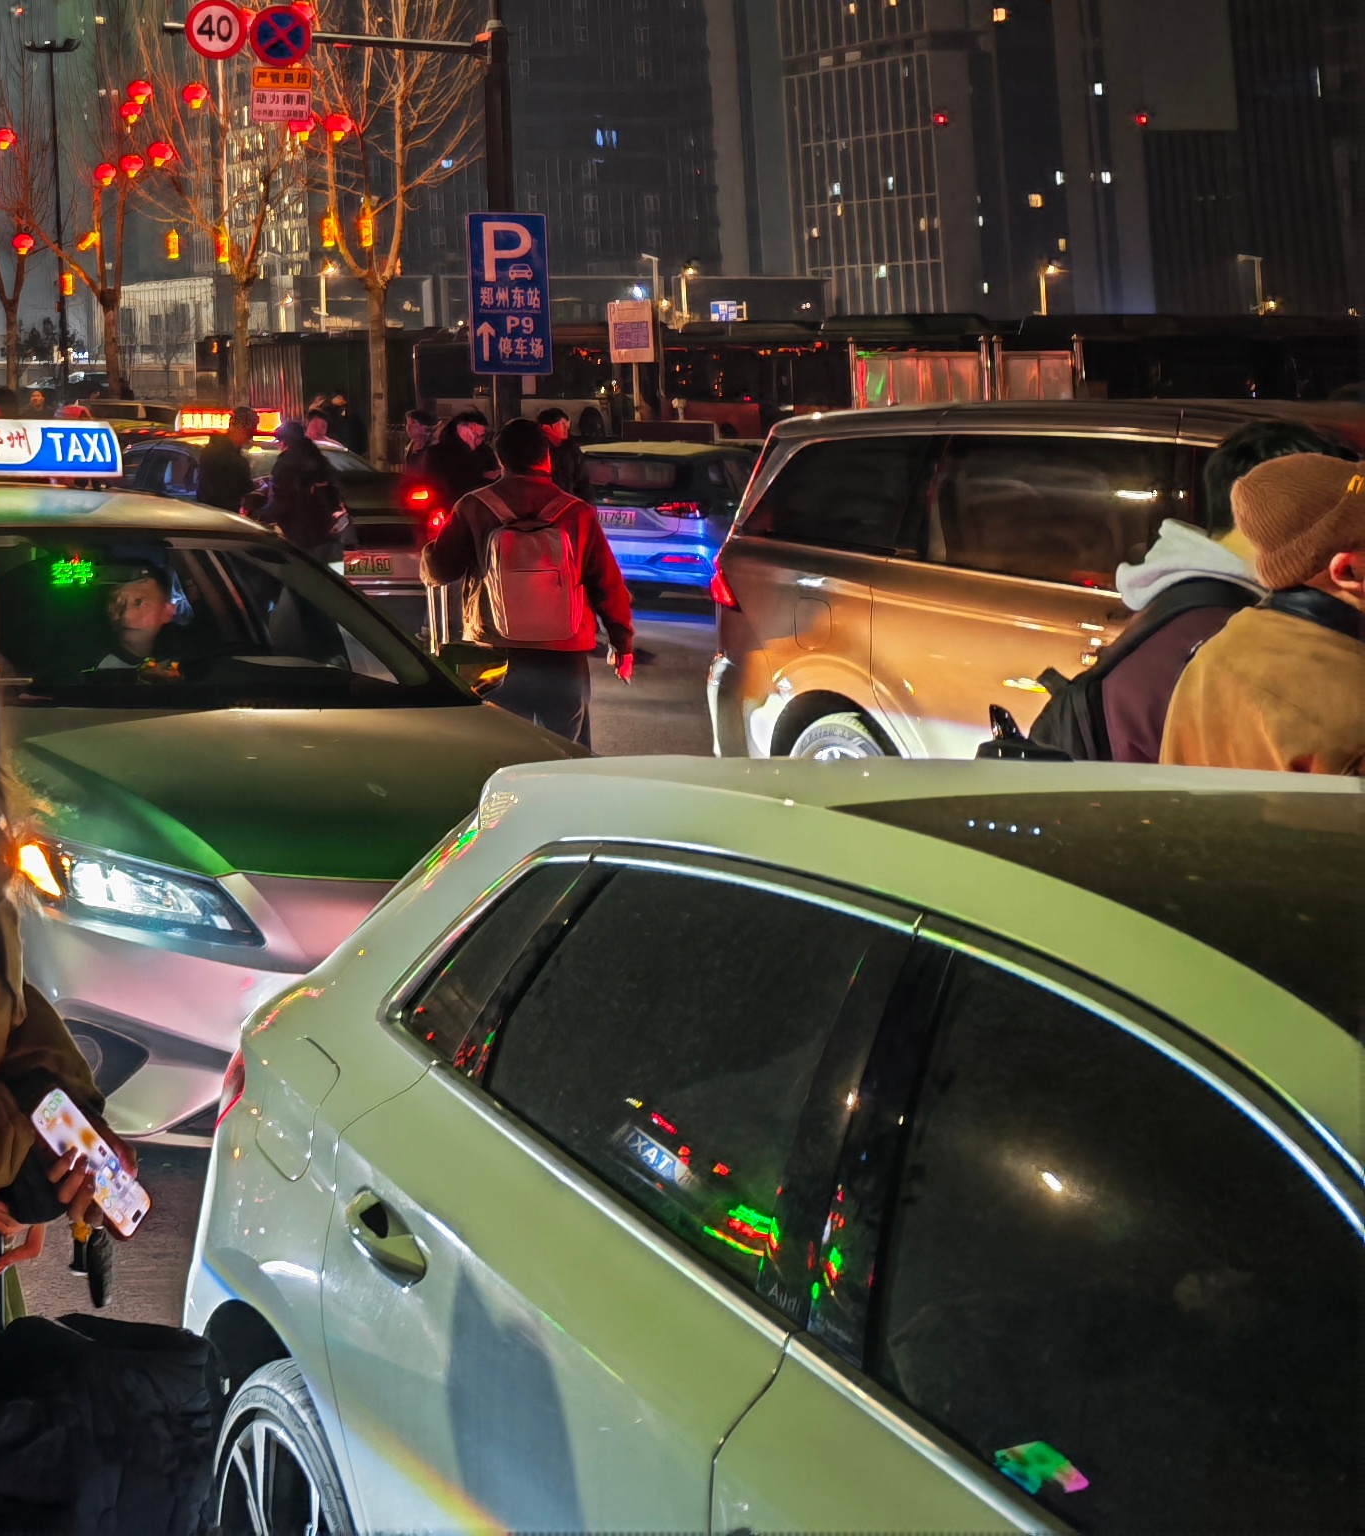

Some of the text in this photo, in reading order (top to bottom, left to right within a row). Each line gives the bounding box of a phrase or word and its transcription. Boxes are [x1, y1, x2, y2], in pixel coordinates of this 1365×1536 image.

[197, 15, 233, 43] 40
[482, 221, 532, 282] P
[480, 286, 541, 309] 郑州东站
[506, 315, 535, 335] P9
[498, 336, 545, 360] 停车场
[47, 432, 113, 463] TAXI
